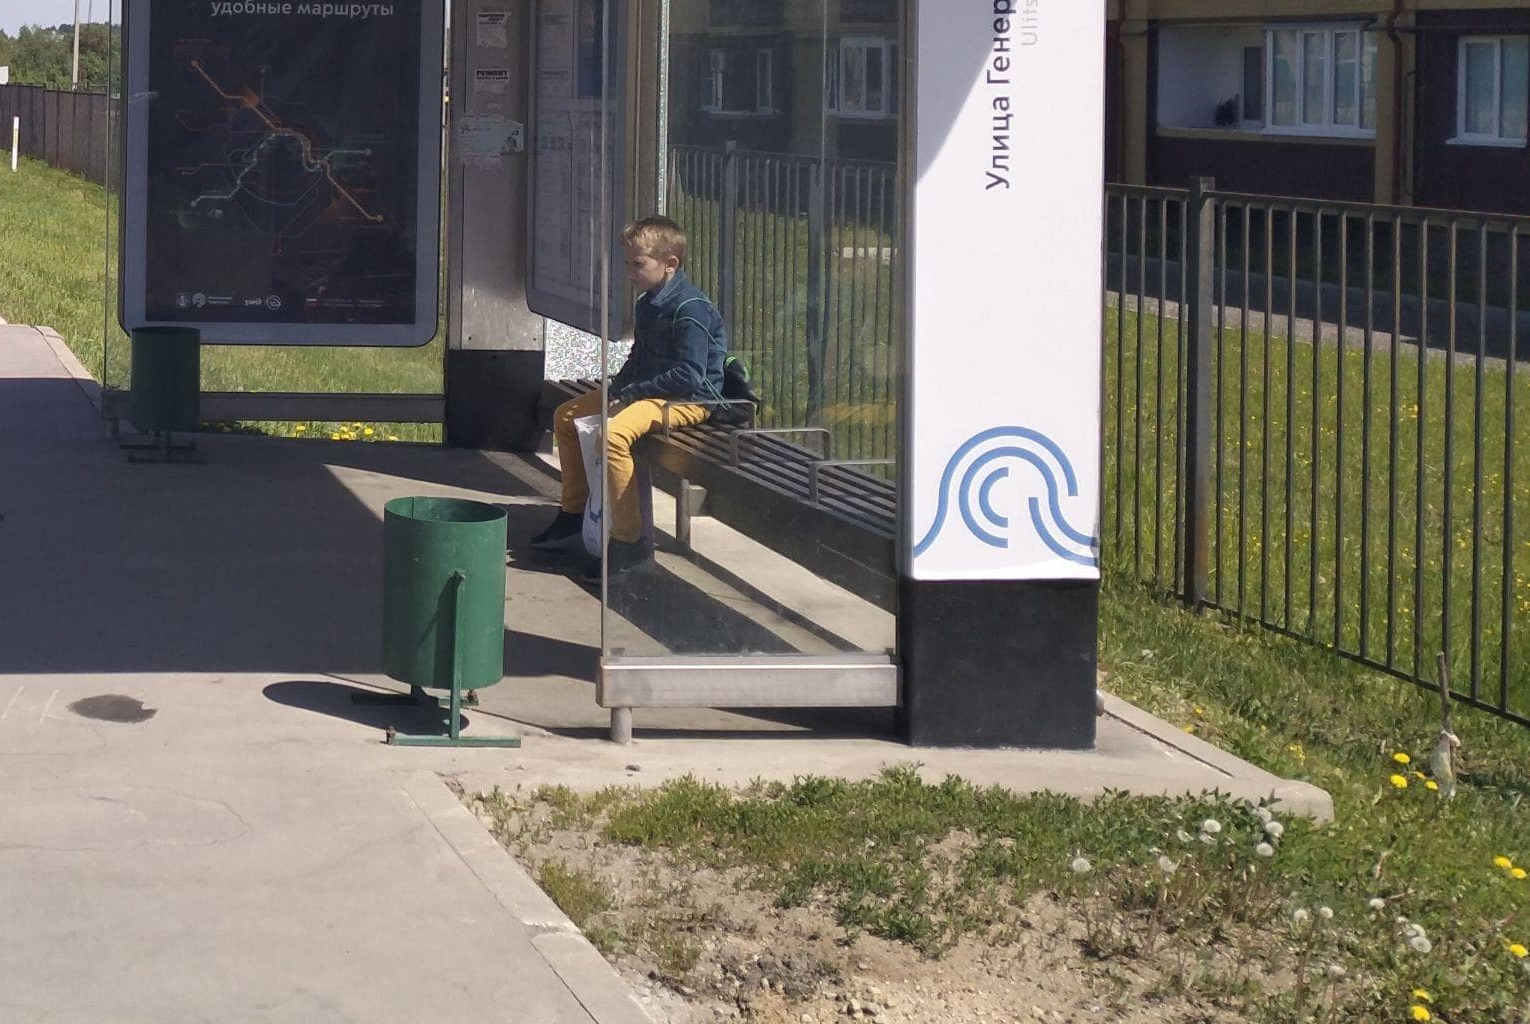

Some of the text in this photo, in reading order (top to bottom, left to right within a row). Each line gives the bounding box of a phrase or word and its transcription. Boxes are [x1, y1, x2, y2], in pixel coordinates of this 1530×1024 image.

[210, 0, 394, 19] удобные маршруты
[985, 95, 1014, 190] Улица
